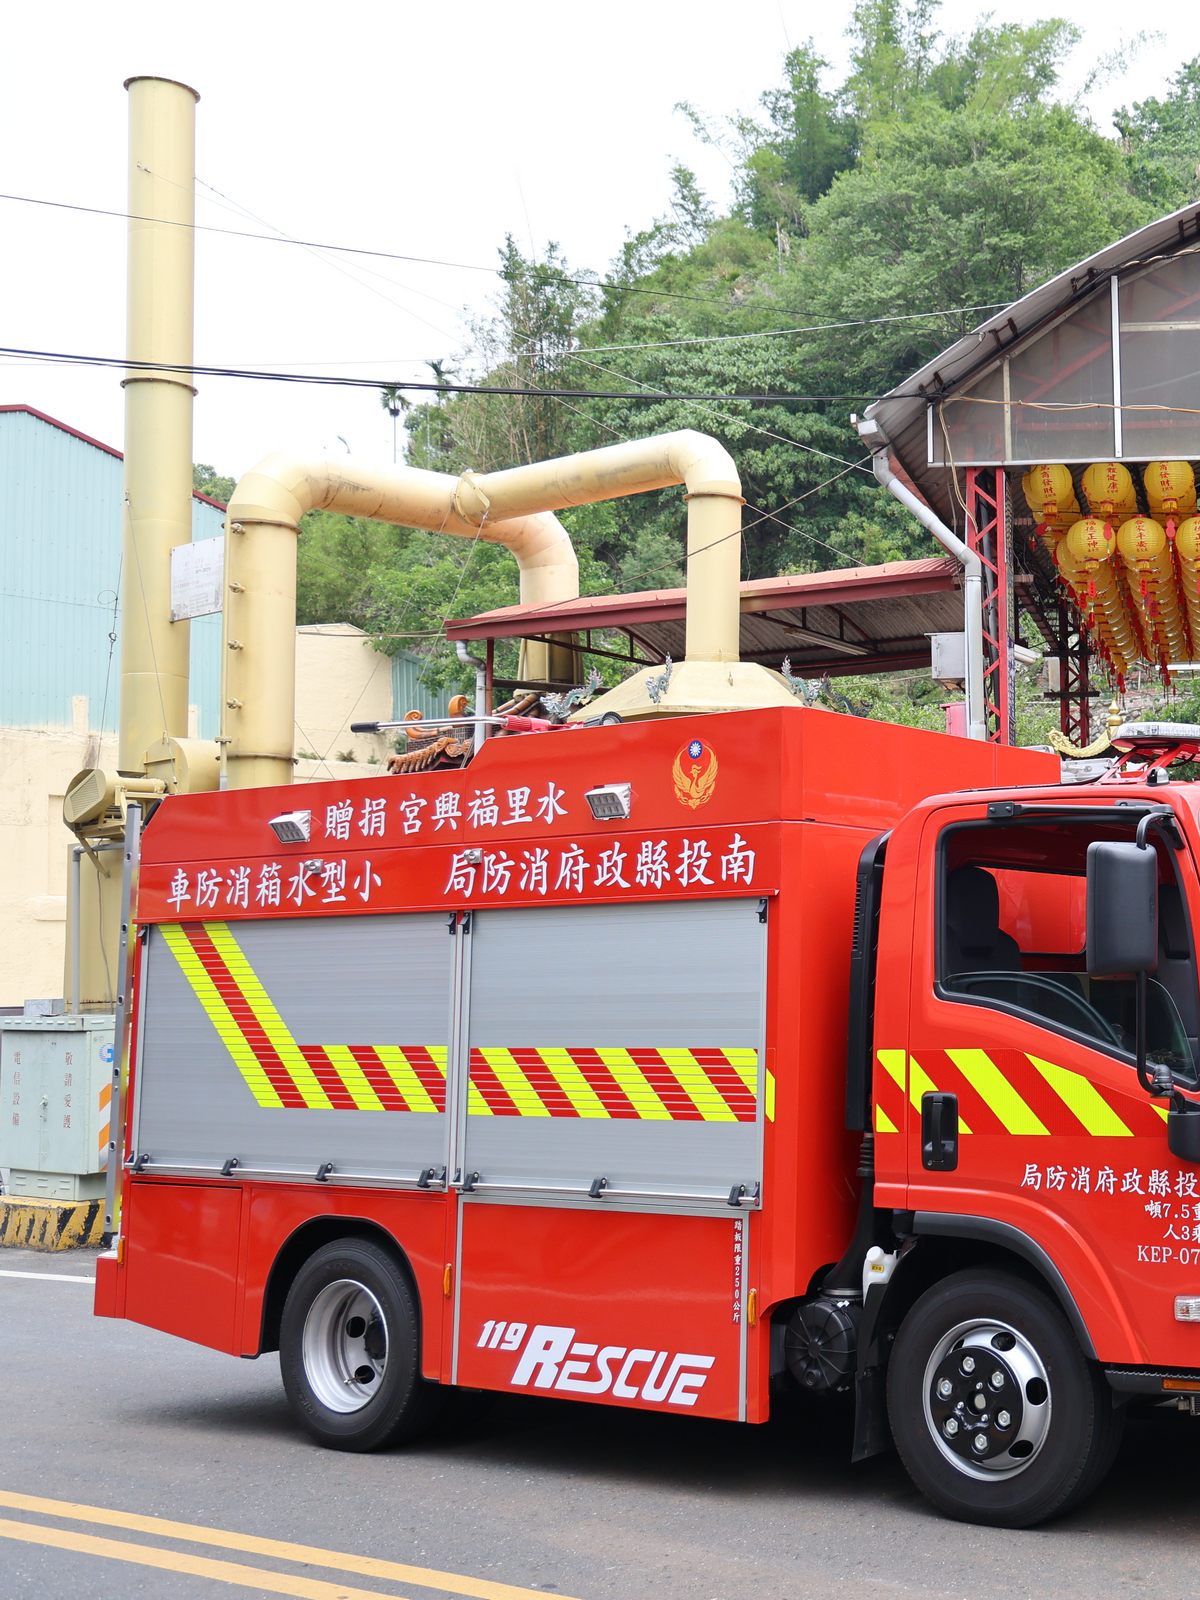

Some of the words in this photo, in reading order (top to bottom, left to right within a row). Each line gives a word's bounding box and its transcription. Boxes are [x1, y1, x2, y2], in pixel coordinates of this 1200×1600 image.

[732, 1219, 743, 1323] 踏板限重250公斤
[476, 1319, 528, 1351] 119
